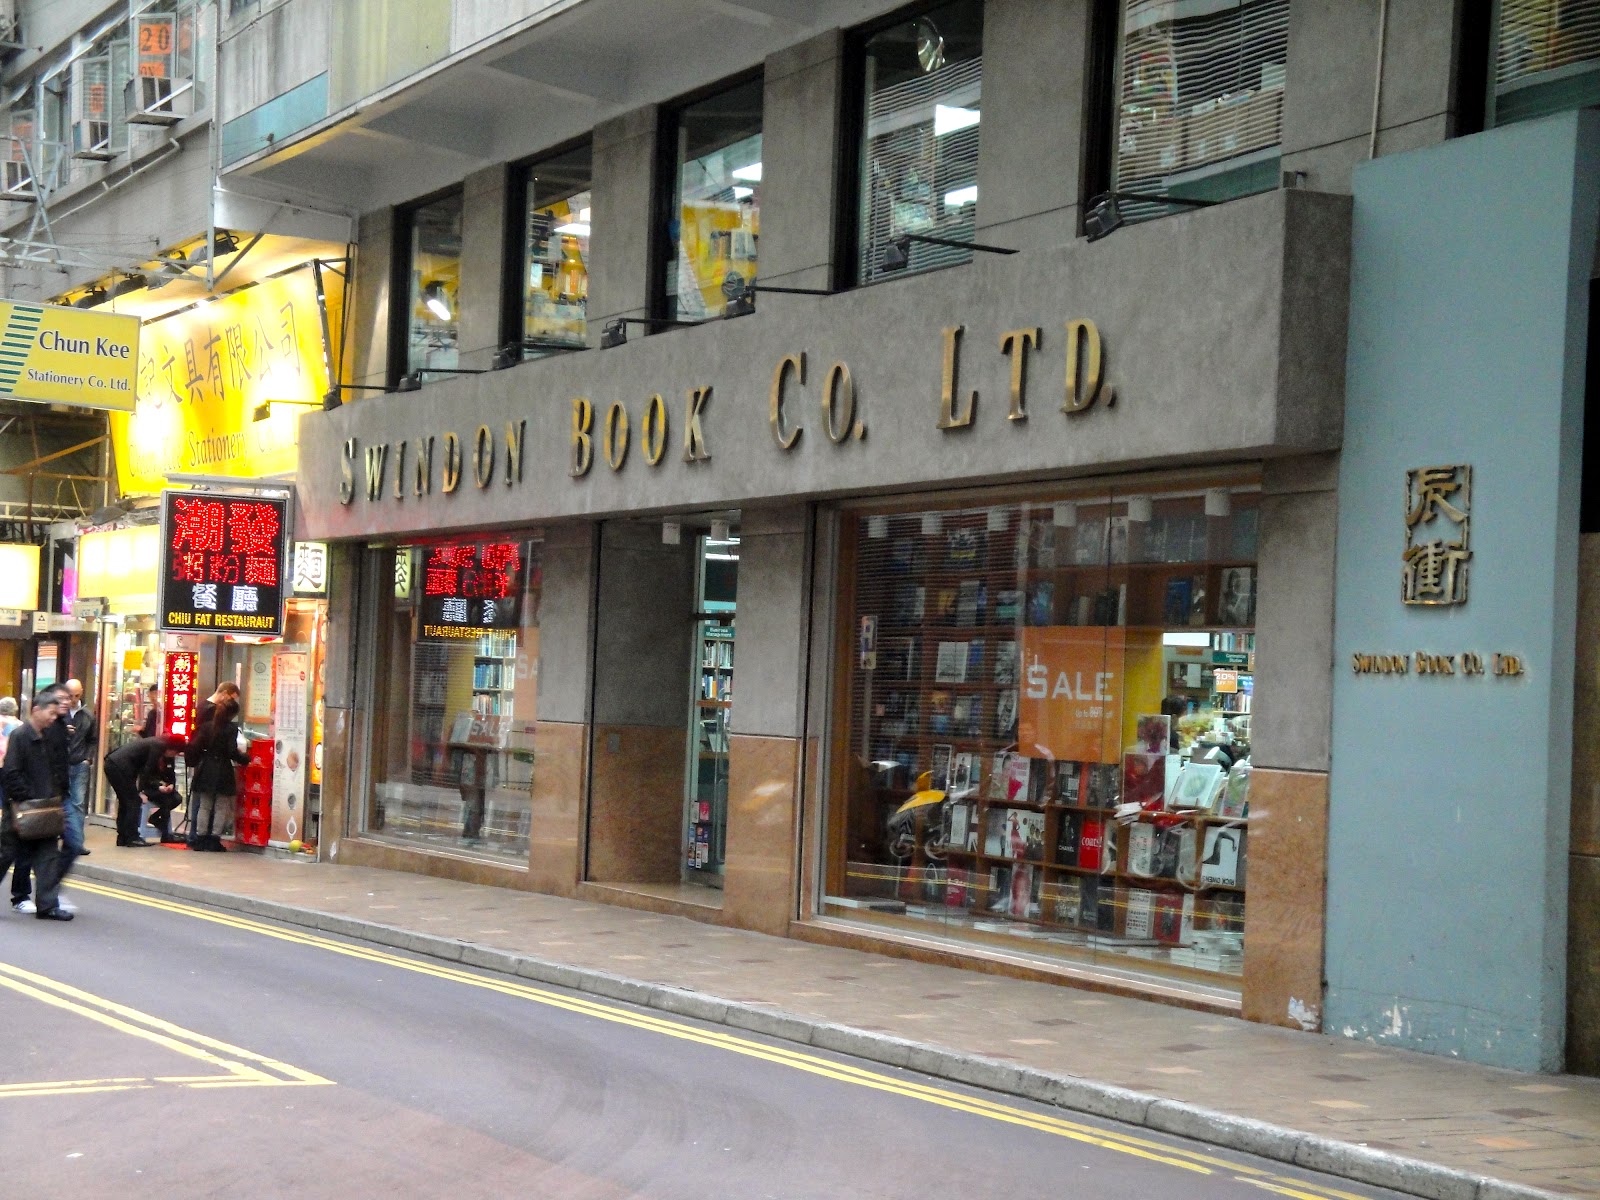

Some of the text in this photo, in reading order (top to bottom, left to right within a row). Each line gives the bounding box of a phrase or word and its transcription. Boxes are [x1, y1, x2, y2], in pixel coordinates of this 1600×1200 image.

[141, 26, 170, 51] 20
[40, 331, 131, 359] Chun Kee
[28, 369, 131, 391] Stationery Co. Ltd.
[339, 318, 1118, 505] SWINDON BOOK CO. LTD.
[172, 498, 279, 554] 潮發
[168, 612, 275, 629] CHIU FAT RESTAURAUT
[1026, 664, 1114, 702] SALE
